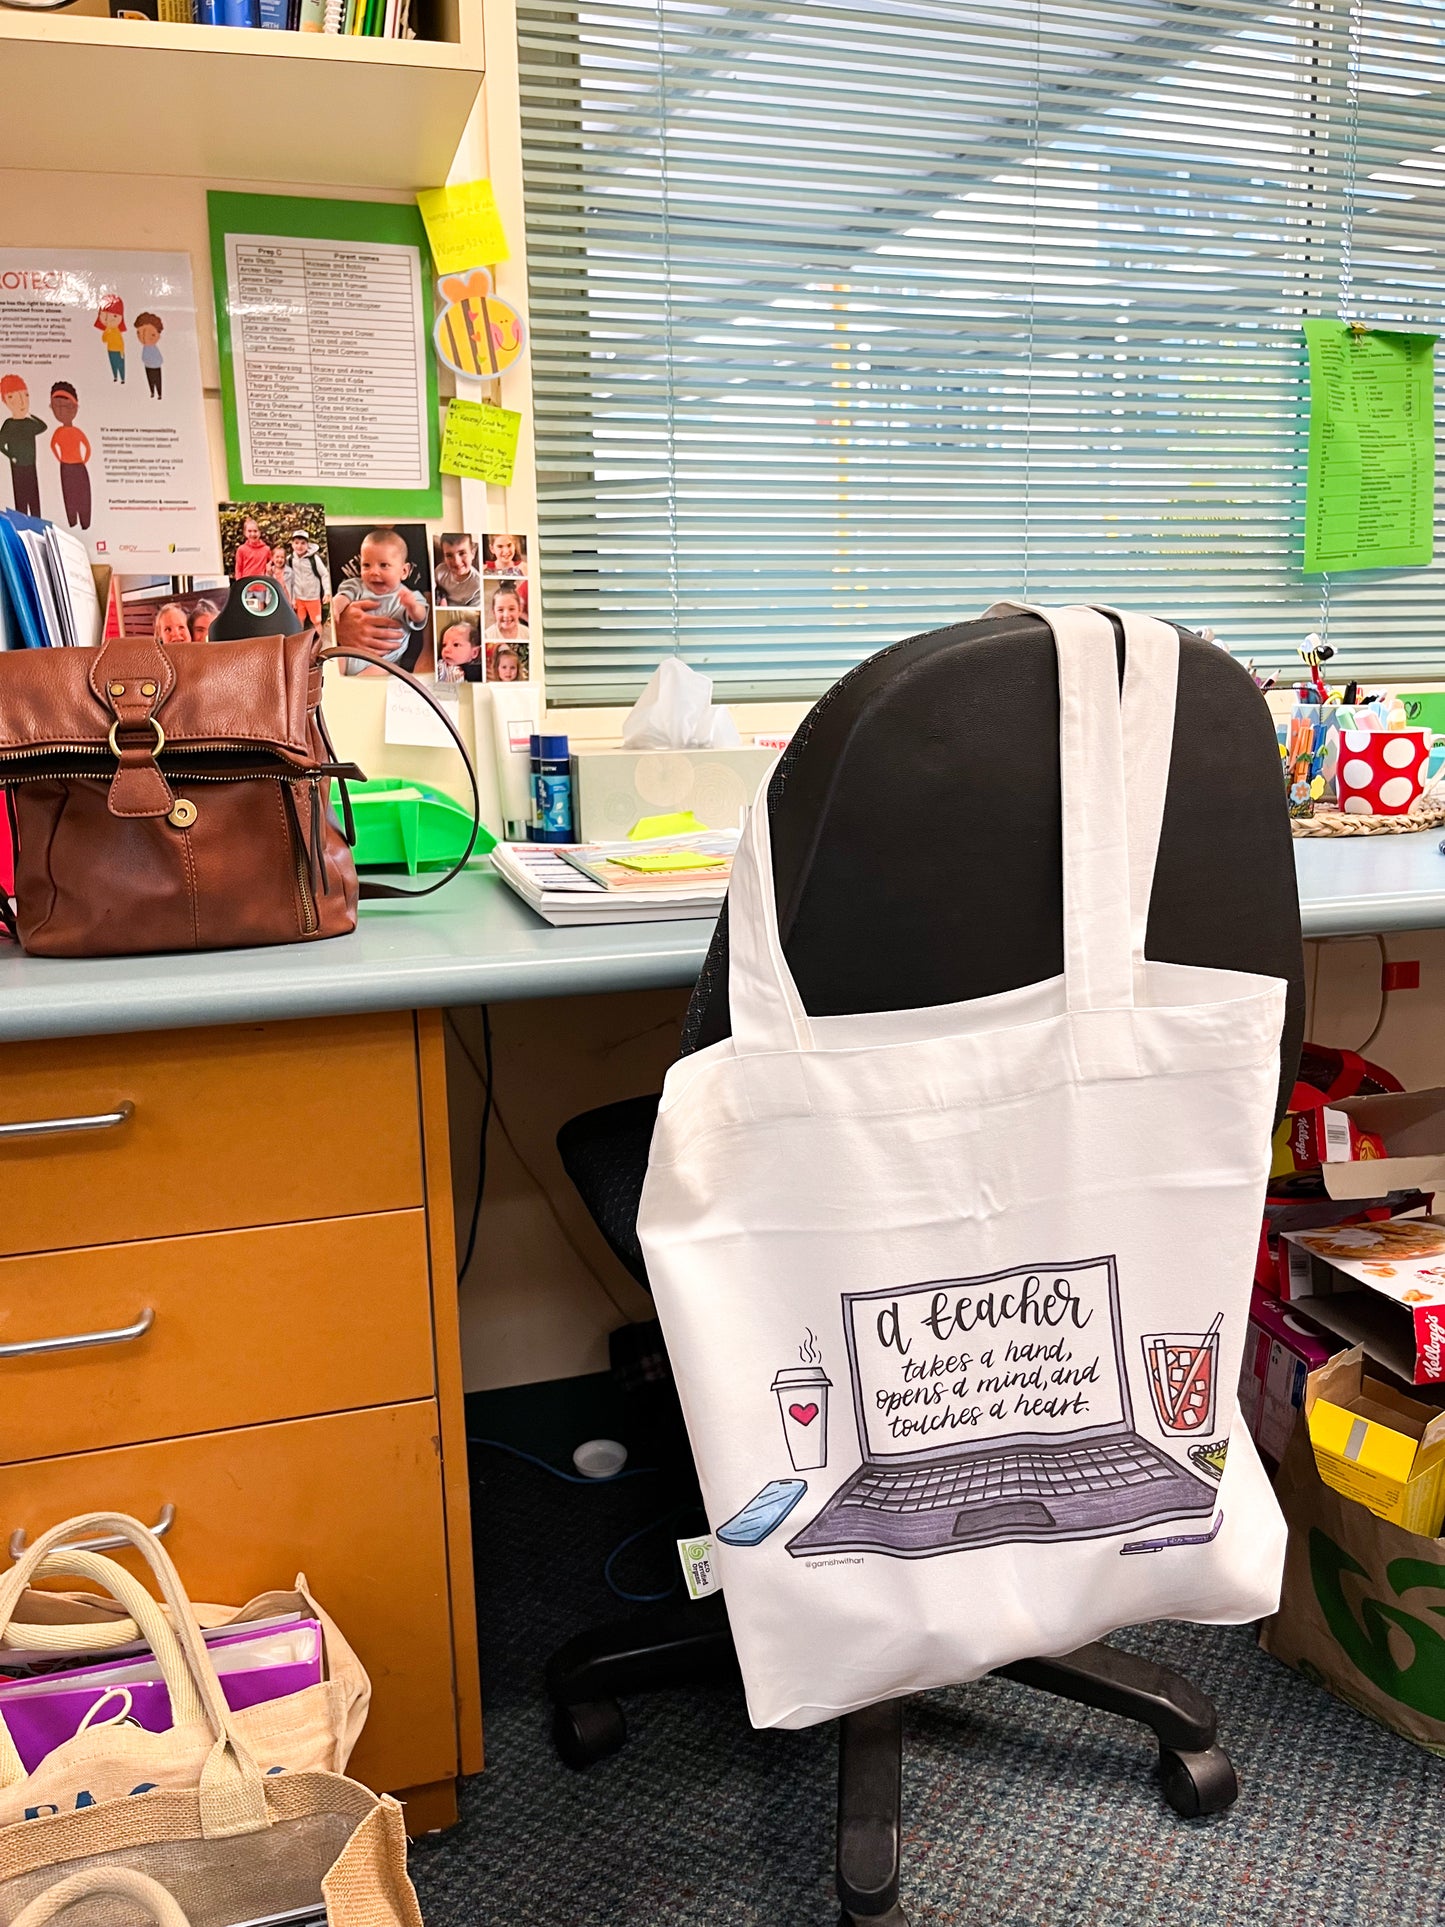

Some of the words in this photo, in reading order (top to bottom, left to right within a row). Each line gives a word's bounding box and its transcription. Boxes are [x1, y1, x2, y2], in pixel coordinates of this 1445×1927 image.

[1295, 1117, 1310, 1160] Kellogg's
[877, 1302, 912, 1355] a
[921, 1276, 1093, 1339] teacher
[902, 1354, 974, 1382] takes
[981, 1352, 994, 1369] a
[1005, 1339, 1072, 1363] hand,
[1421, 1313, 1445, 1379] Kellogg's
[876, 1384, 948, 1416] opens
[953, 1378, 968, 1398] a
[889, 1404, 983, 1437] touches
[990, 1401, 1007, 1418] a
[1014, 1392, 1090, 1418] heart.
[805, 1556, 865, 1569] @garnishwithart
